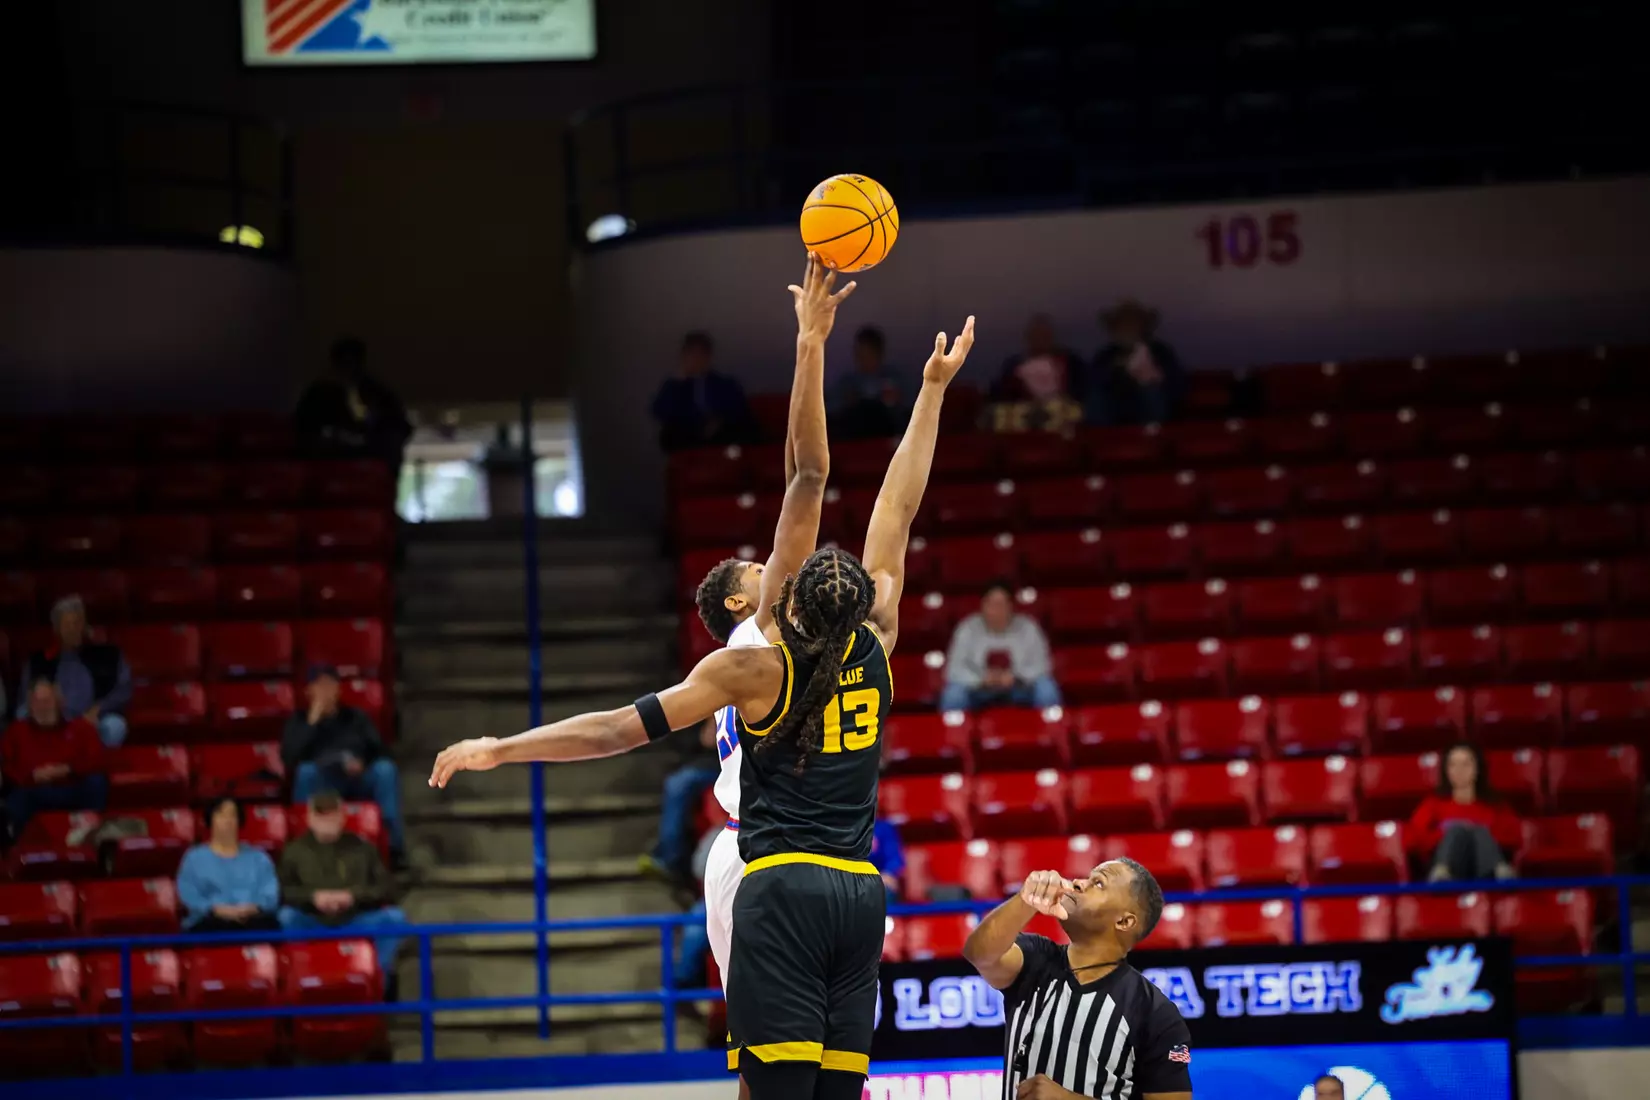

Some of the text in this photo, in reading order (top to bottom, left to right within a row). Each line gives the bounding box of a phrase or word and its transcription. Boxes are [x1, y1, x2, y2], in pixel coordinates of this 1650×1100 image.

[1195, 212, 1303, 270] 105
[821, 687, 880, 754] 13
[1204, 960, 1364, 1018] TECH
